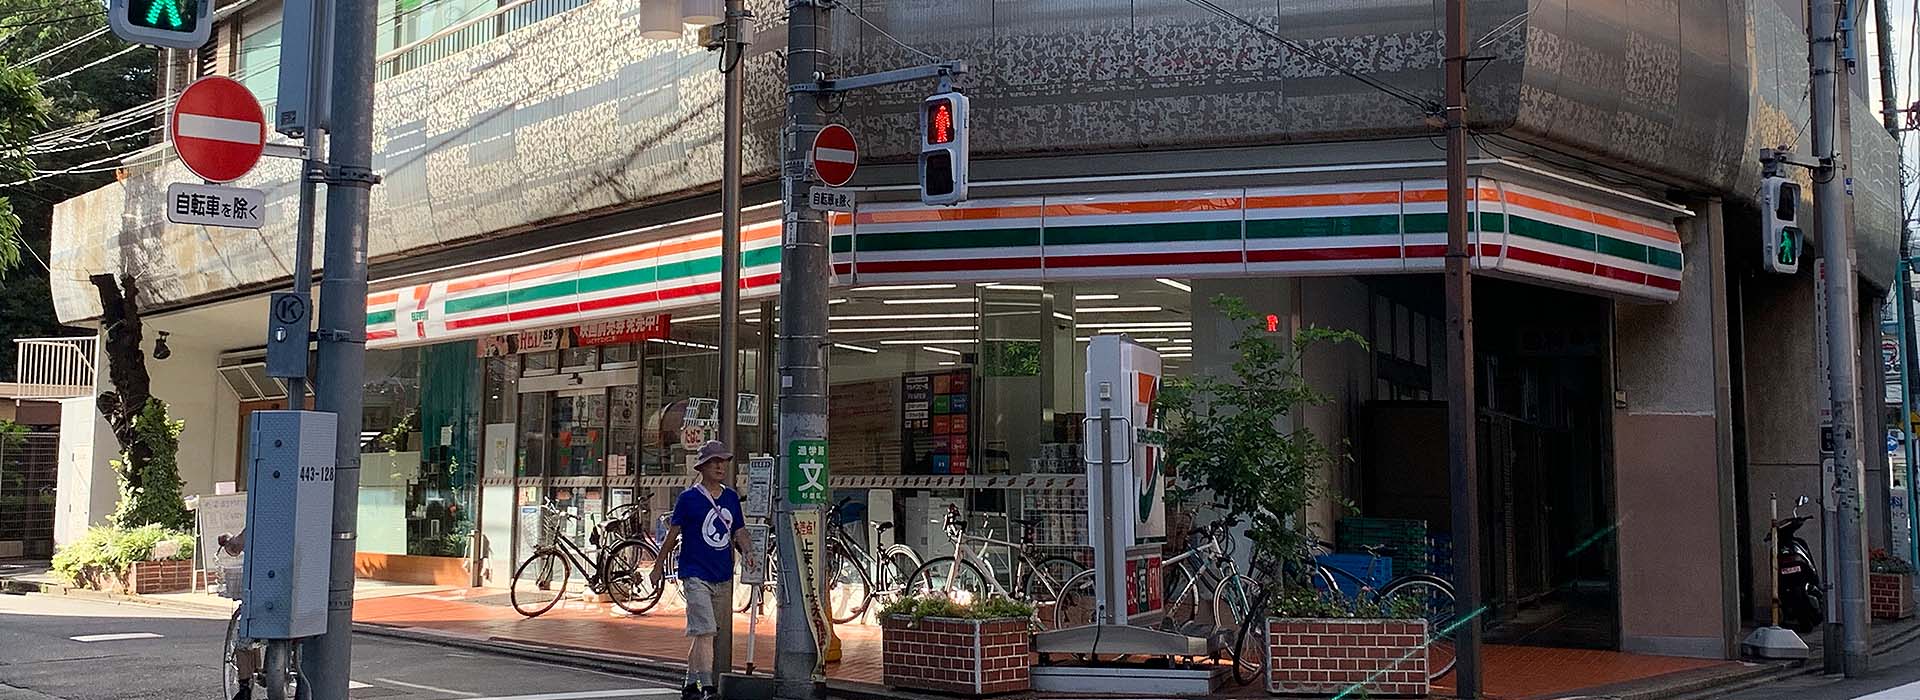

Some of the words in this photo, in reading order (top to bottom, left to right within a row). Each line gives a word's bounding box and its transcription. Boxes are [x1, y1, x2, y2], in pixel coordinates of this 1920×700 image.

[177, 192, 258, 220] 自転車を除く
[813, 192, 851, 208] 自転車を除く
[282, 301, 298, 319] K
[300, 466, 335, 482] 443-128
[798, 459, 824, 491] 文
